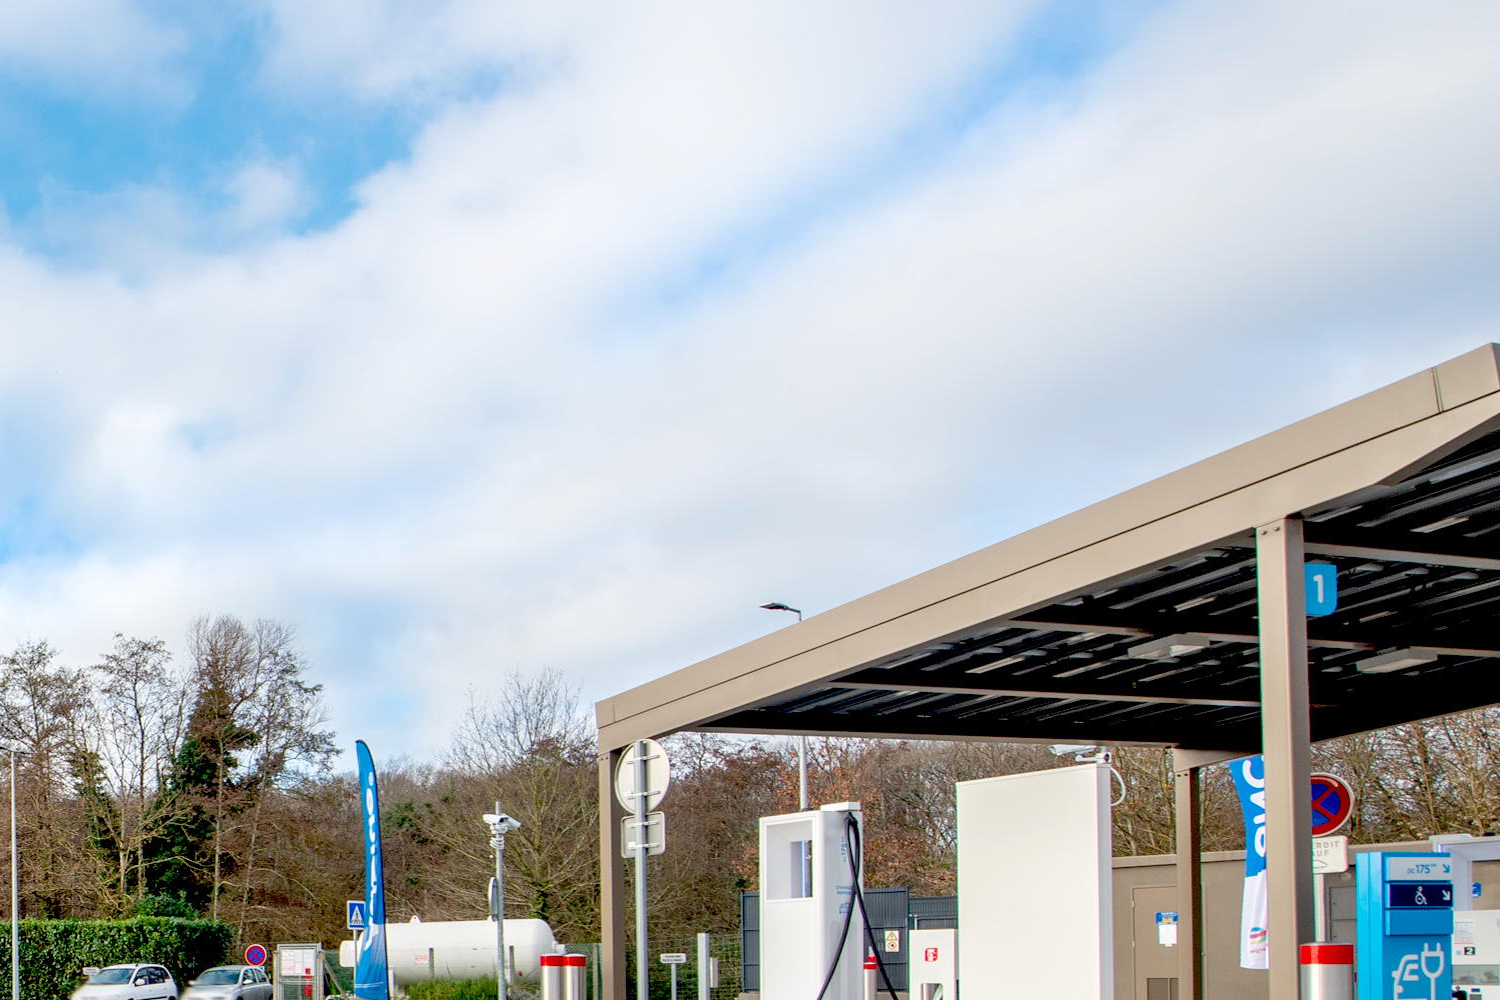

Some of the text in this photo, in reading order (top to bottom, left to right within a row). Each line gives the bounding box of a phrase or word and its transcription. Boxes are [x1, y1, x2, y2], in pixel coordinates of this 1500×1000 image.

[1313, 574, 1324, 604] 1
[1415, 864, 1431, 874] 175
[1465, 947, 1474, 955] 2
